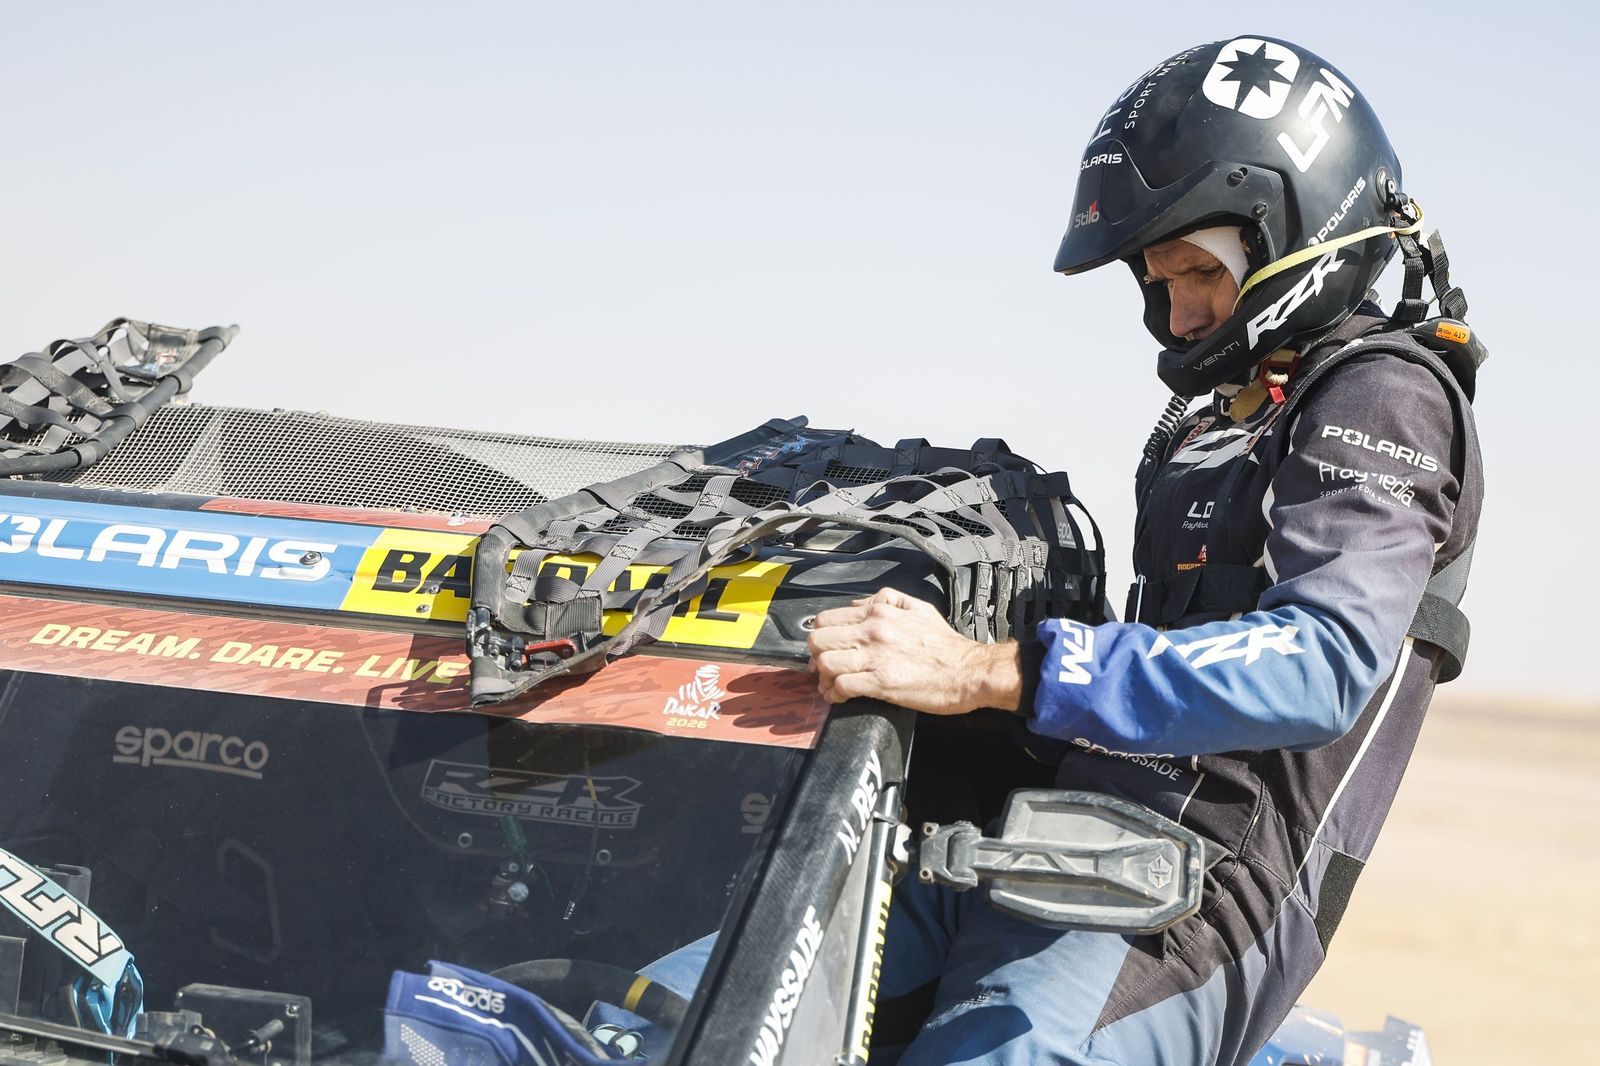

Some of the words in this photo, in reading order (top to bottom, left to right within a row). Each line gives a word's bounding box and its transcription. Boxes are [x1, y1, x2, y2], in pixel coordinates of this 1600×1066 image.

[1124, 81, 1157, 130] SPORT
[1317, 176, 1366, 242] POLARIS
[1246, 248, 1346, 350] RZR
[1192, 340, 1241, 371] VENTI
[1321, 425, 1439, 472] POLARIS
[0, 513, 338, 582] OLARIS
[28, 623, 201, 660] DREAM.
[209, 641, 346, 675] DARE.
[666, 717, 708, 729] 2026
[113, 725, 269, 779] sparco
[422, 788, 531, 815] FACTORY
[540, 805, 634, 826] RACING
[852, 750, 883, 832] REY
